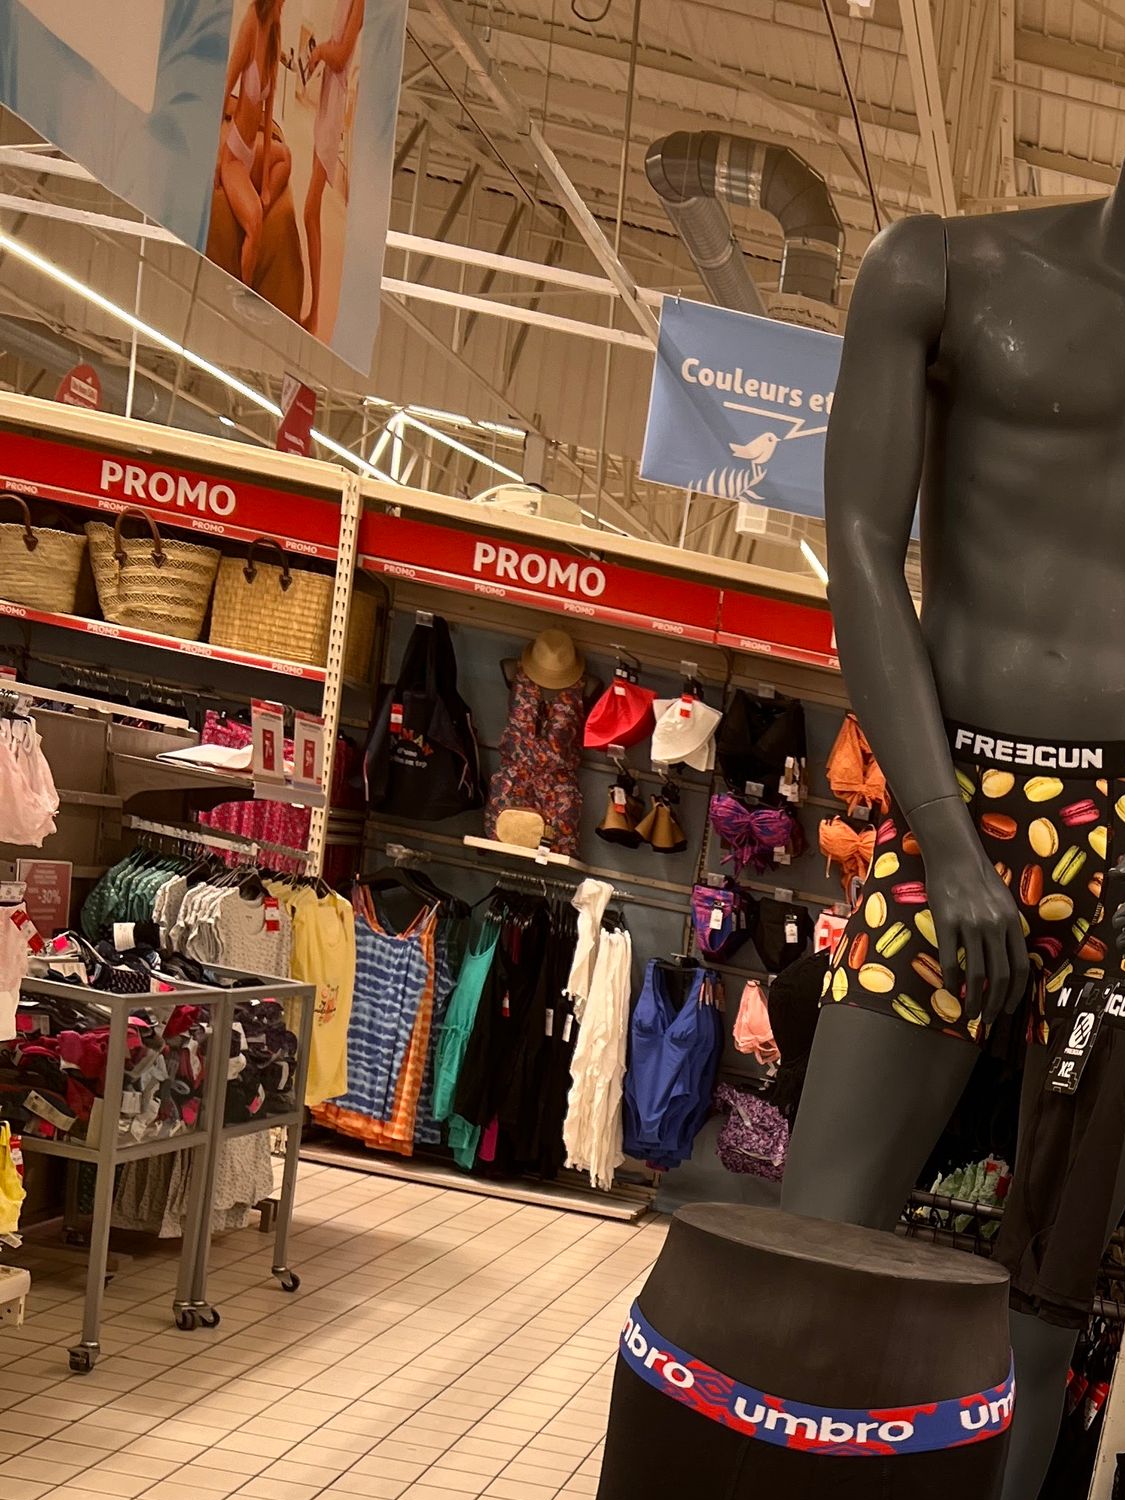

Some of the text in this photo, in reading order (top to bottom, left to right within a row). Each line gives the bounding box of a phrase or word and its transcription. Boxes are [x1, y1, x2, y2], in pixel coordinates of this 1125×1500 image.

[680, 357, 835, 415] Couleurs et
[100, 458, 237, 517] PROMO
[5, 480, 38, 495] PROMO
[191, 519, 225, 534] PROMO
[285, 540, 318, 554] PROMO
[472, 541, 606, 597] PROMO
[383, 563, 684, 634] PROMO PROMO PROMO PROMO
[86, 622, 120, 637] PROMO
[180, 642, 213, 657] PROMO
[272, 662, 304, 676] PROMO
[740, 638, 772, 652] PROMO
[1057, 1061, 1075, 1078] X2
[733, 1395, 914, 1444] umbro
